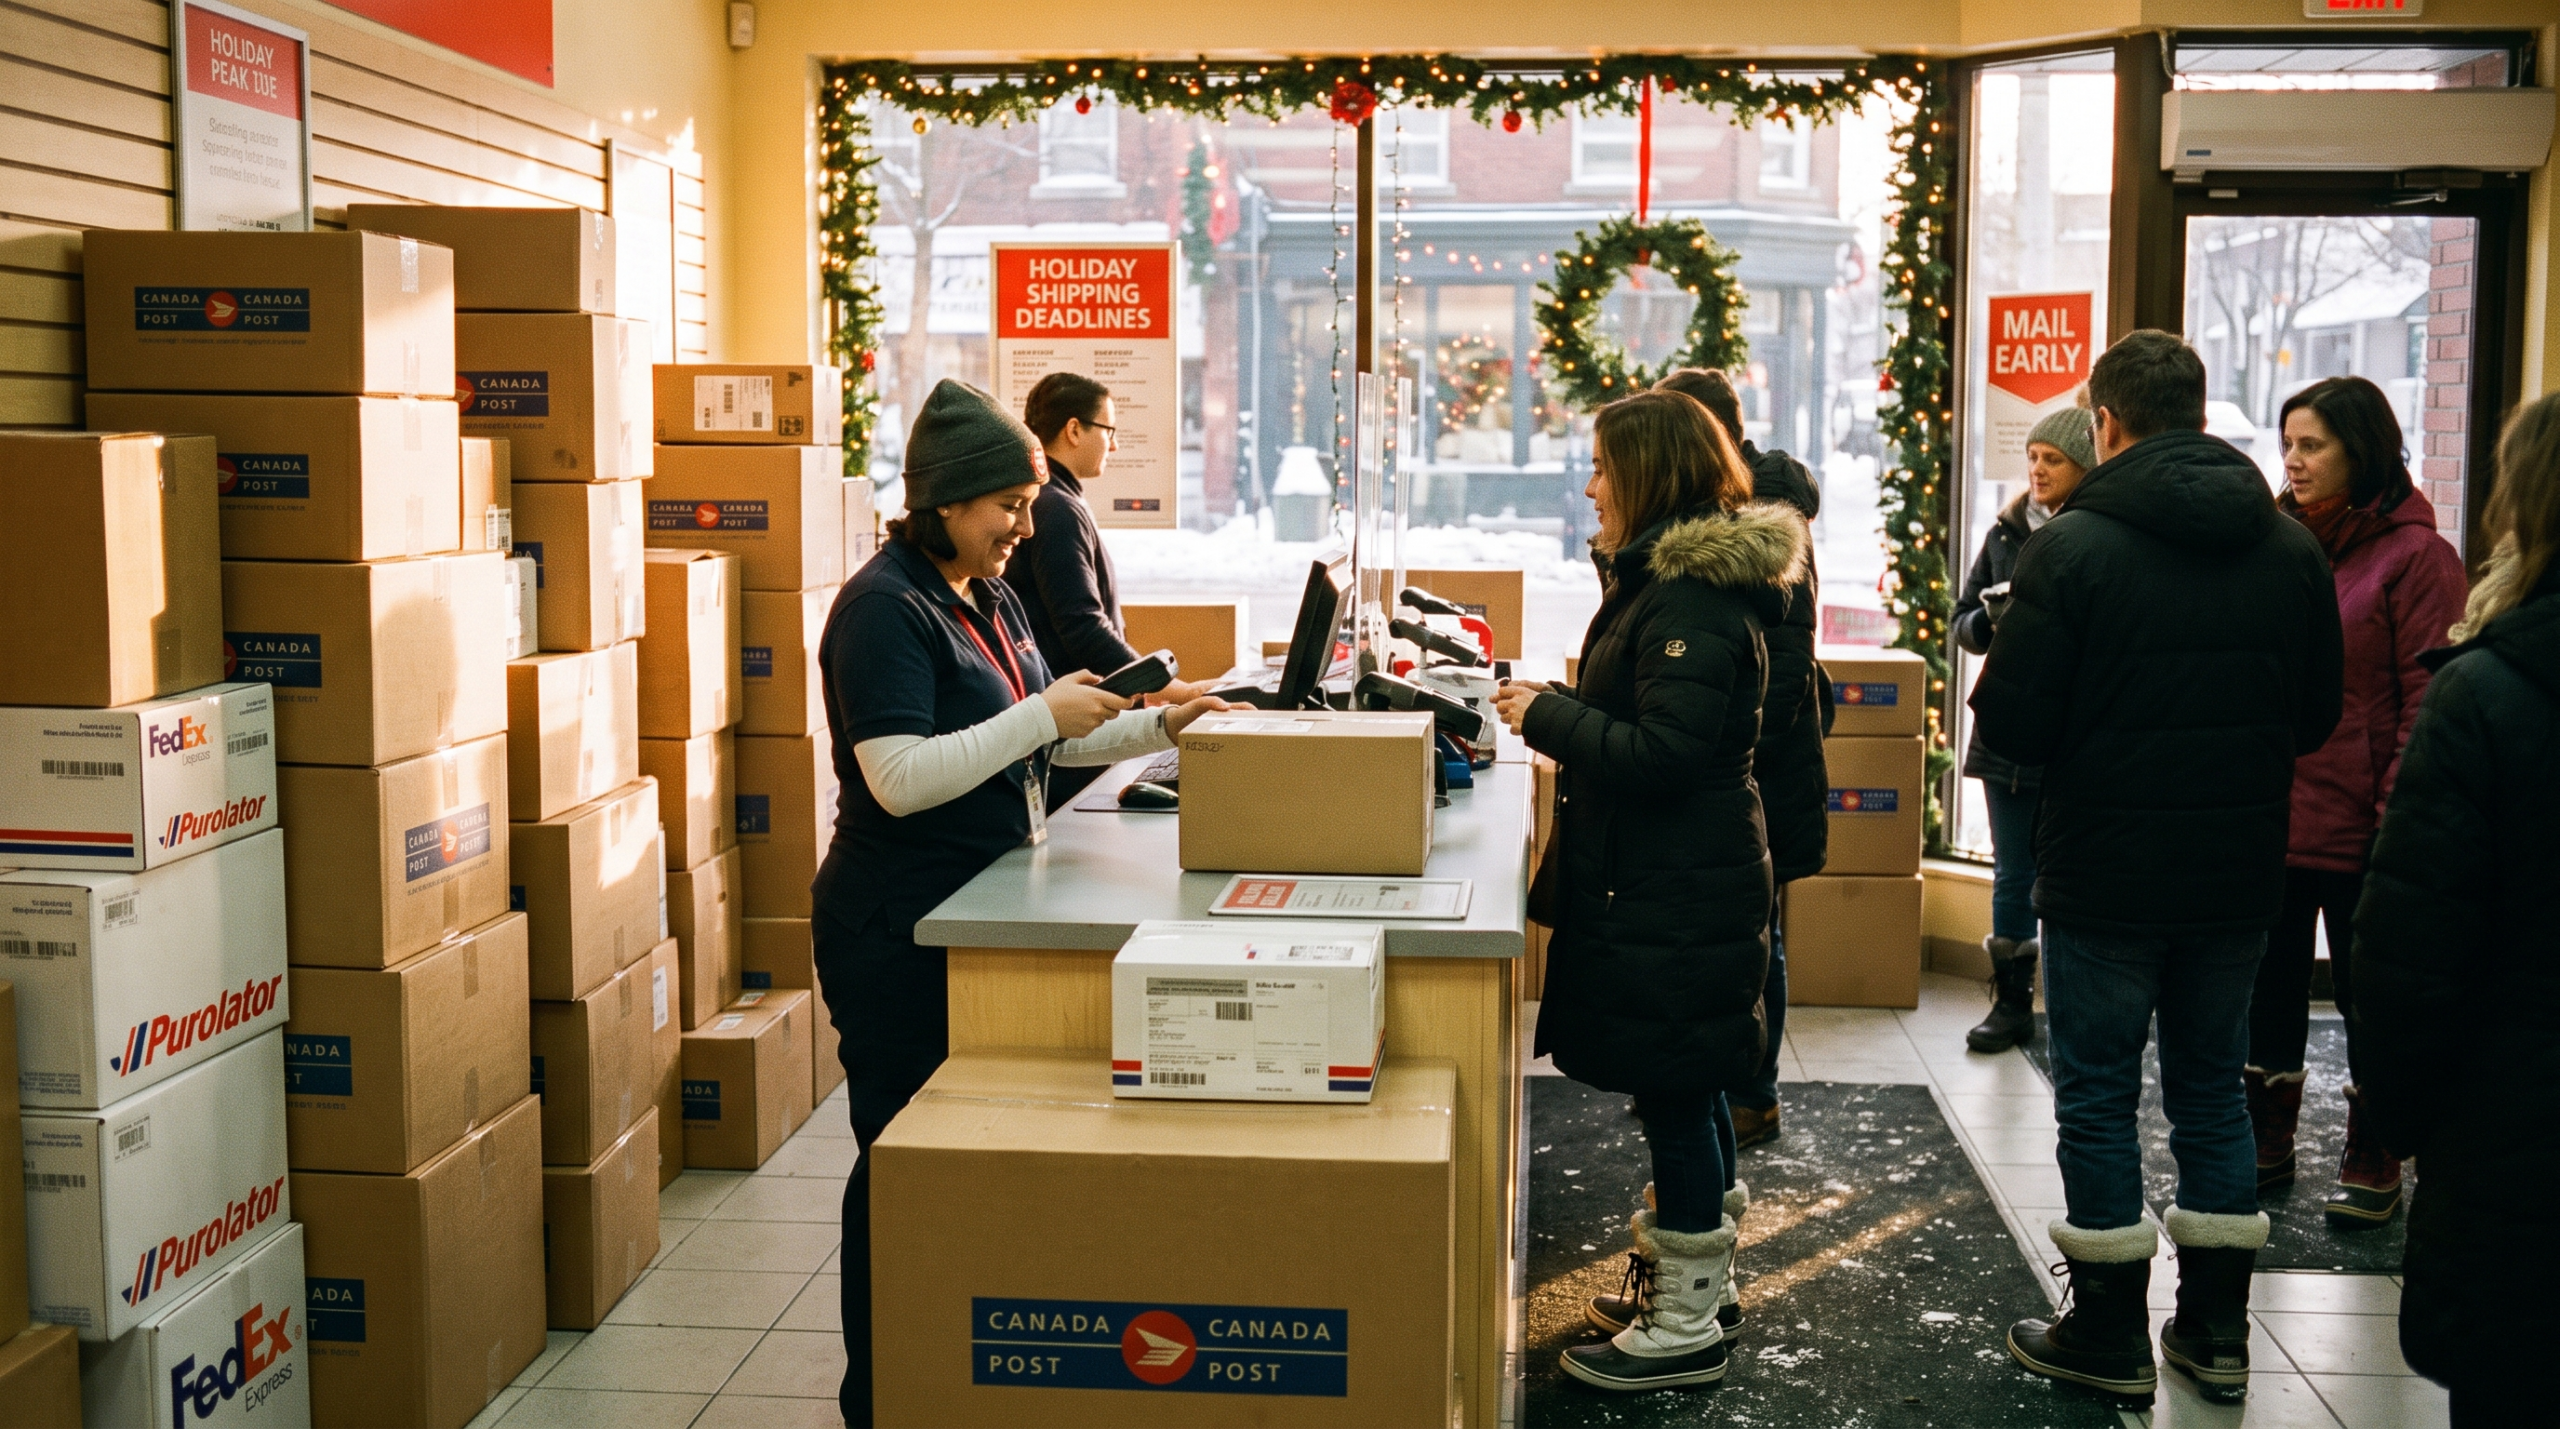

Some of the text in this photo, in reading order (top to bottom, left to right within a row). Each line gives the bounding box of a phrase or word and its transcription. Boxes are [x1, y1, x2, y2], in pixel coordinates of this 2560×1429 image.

[211, 28, 274, 69] HOLIDAY
[211, 58, 249, 91] PEAK
[1029, 258, 1138, 280] HOLIDAY
[142, 294, 302, 305] CANADA CANADA
[1026, 283, 1140, 304] SHIPPING
[143, 314, 279, 325] POST POST
[1015, 308, 1151, 329] DEADLINES
[2003, 307, 2075, 340] MAIL
[1995, 342, 2083, 375] EARLY
[480, 378, 541, 389] CANADA
[481, 400, 517, 410] POST
[243, 460, 301, 471] CANADA
[243, 481, 278, 491] POST
[243, 641, 311, 654] CANADA
[244, 666, 284, 678] POST
[149, 715, 207, 758] FedEx
[177, 794, 267, 845] Purolator
[409, 856, 429, 873] POST
[145, 973, 283, 1067] Purolator
[287, 1043, 340, 1057] NADA
[684, 1085, 713, 1095] ADA
[153, 1175, 284, 1293] Purolator
[306, 1287, 353, 1302] ADA
[989, 1311, 1332, 1341] CANADA CANADA
[171, 1302, 293, 1429] FedEx
[989, 1355, 1282, 1382] POST POST
[245, 1362, 293, 1413] Express
